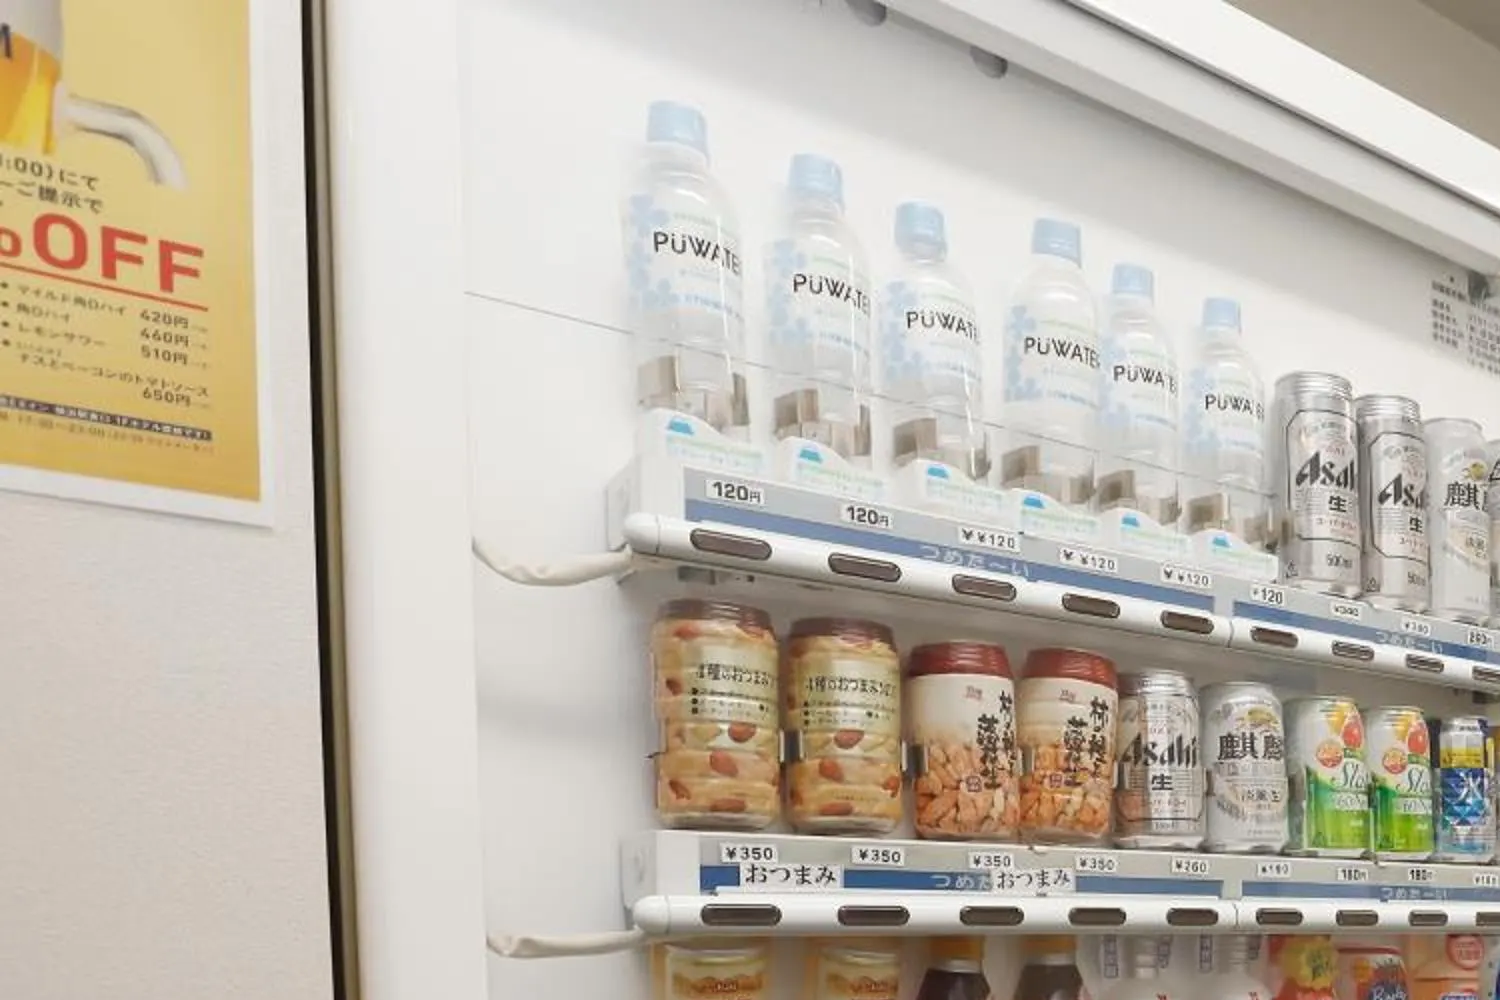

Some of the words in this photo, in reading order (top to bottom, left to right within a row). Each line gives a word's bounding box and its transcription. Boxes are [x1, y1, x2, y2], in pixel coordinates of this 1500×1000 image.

[140, 309, 189, 329] 420円
[140, 328, 190, 348] 460円
[141, 345, 188, 366] 510円
[143, 387, 191, 407] 650円
[712, 481, 762, 502] 120円
[1444, 482, 1489, 513] 麒
[1328, 496, 1347, 513] 生
[846, 507, 889, 527] 120円
[1409, 516, 1424, 533] 生
[1118, 733, 1198, 768] Asahi
[1151, 773, 1174, 791] 生
[726, 847, 773, 861] ¥350
[859, 849, 901, 863] ¥350
[974, 855, 1011, 867] ¥350
[1079, 858, 1115, 870] ¥350
[745, 865, 837, 885] おつまみ
[1175, 860, 1207, 873] ¥260
[998, 868, 1071, 890] おつまみ
